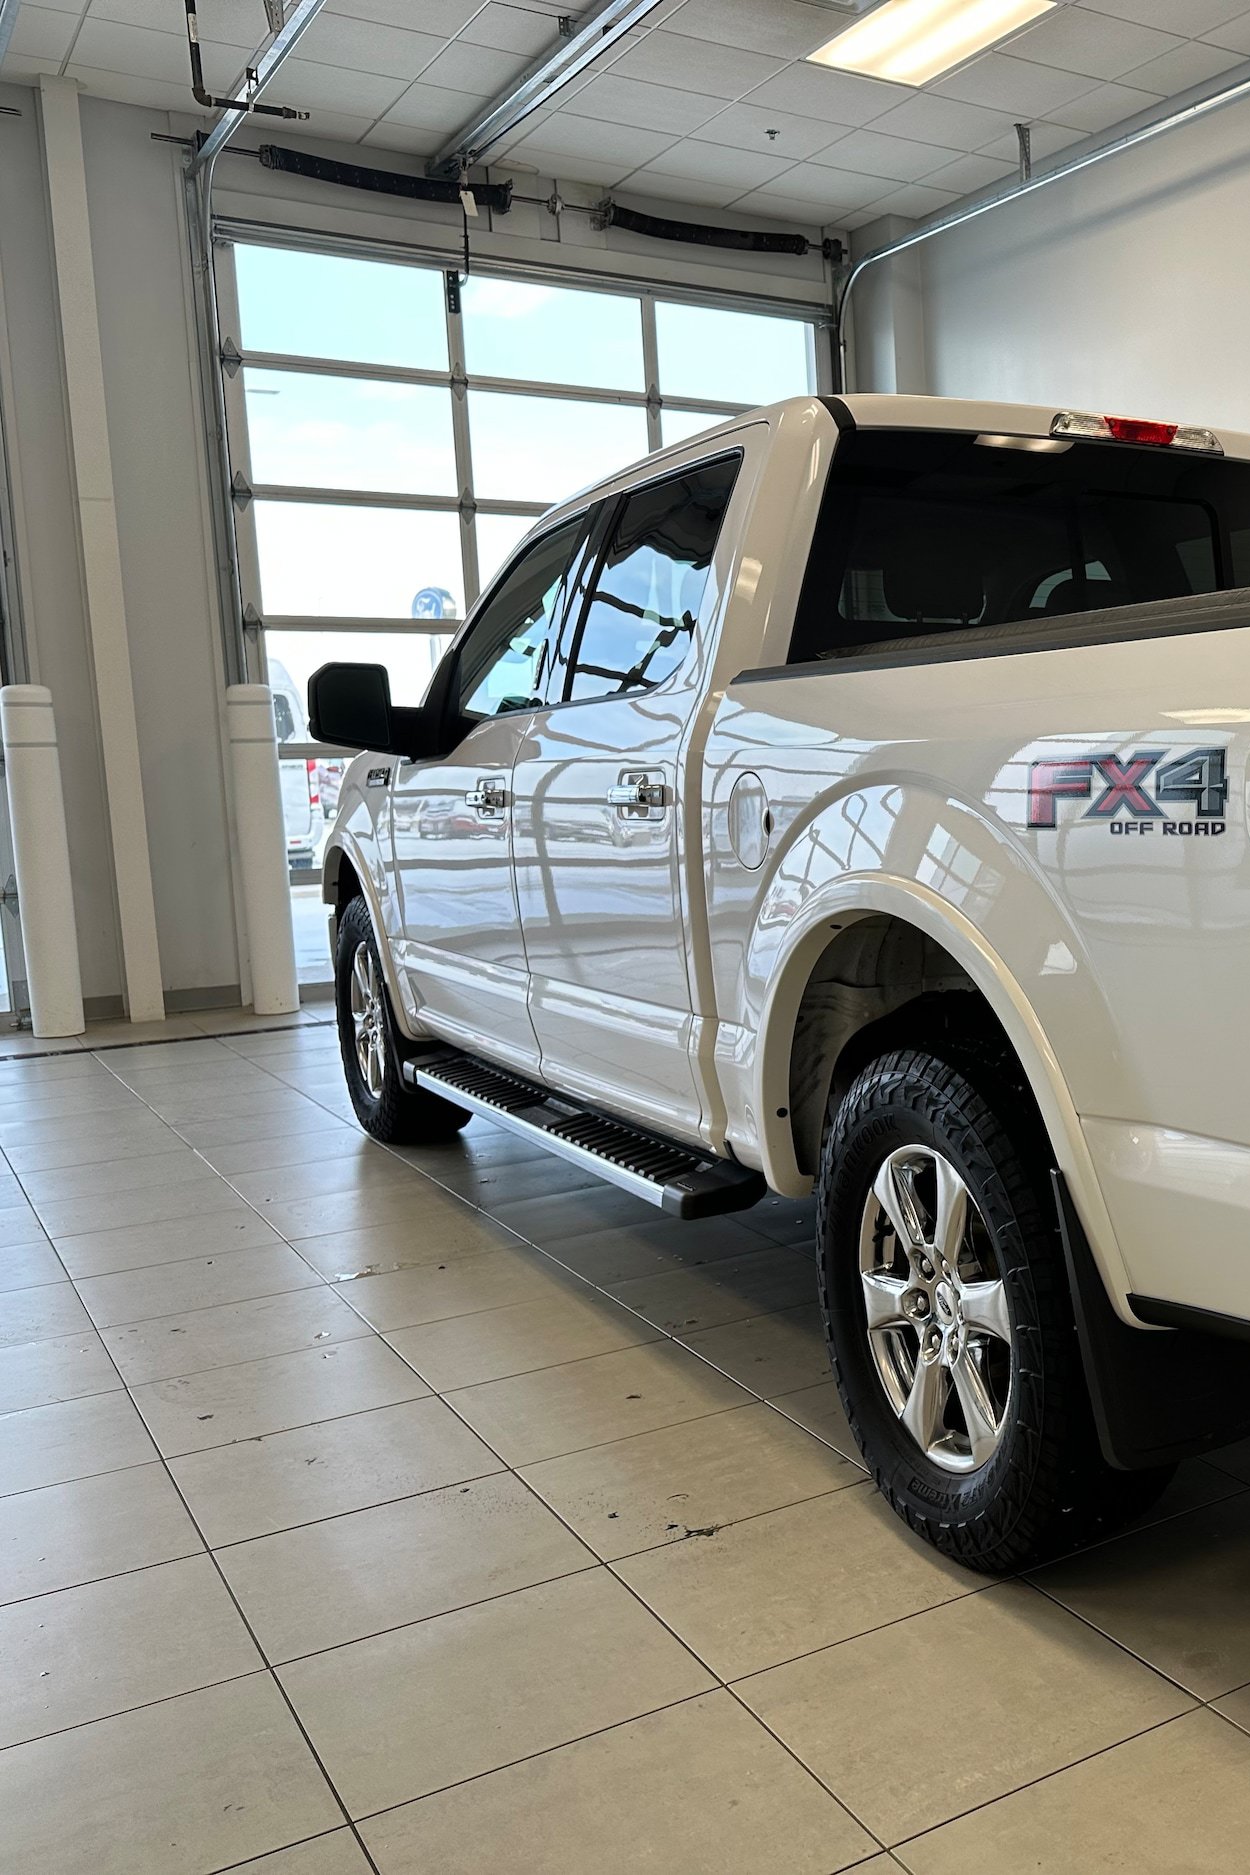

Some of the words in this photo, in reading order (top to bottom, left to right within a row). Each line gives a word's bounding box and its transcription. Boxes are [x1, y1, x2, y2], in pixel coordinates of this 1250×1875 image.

[1026, 746, 1229, 830] FX4
[1110, 821, 1154, 836] OFF
[1162, 821, 1227, 837] ROAD
